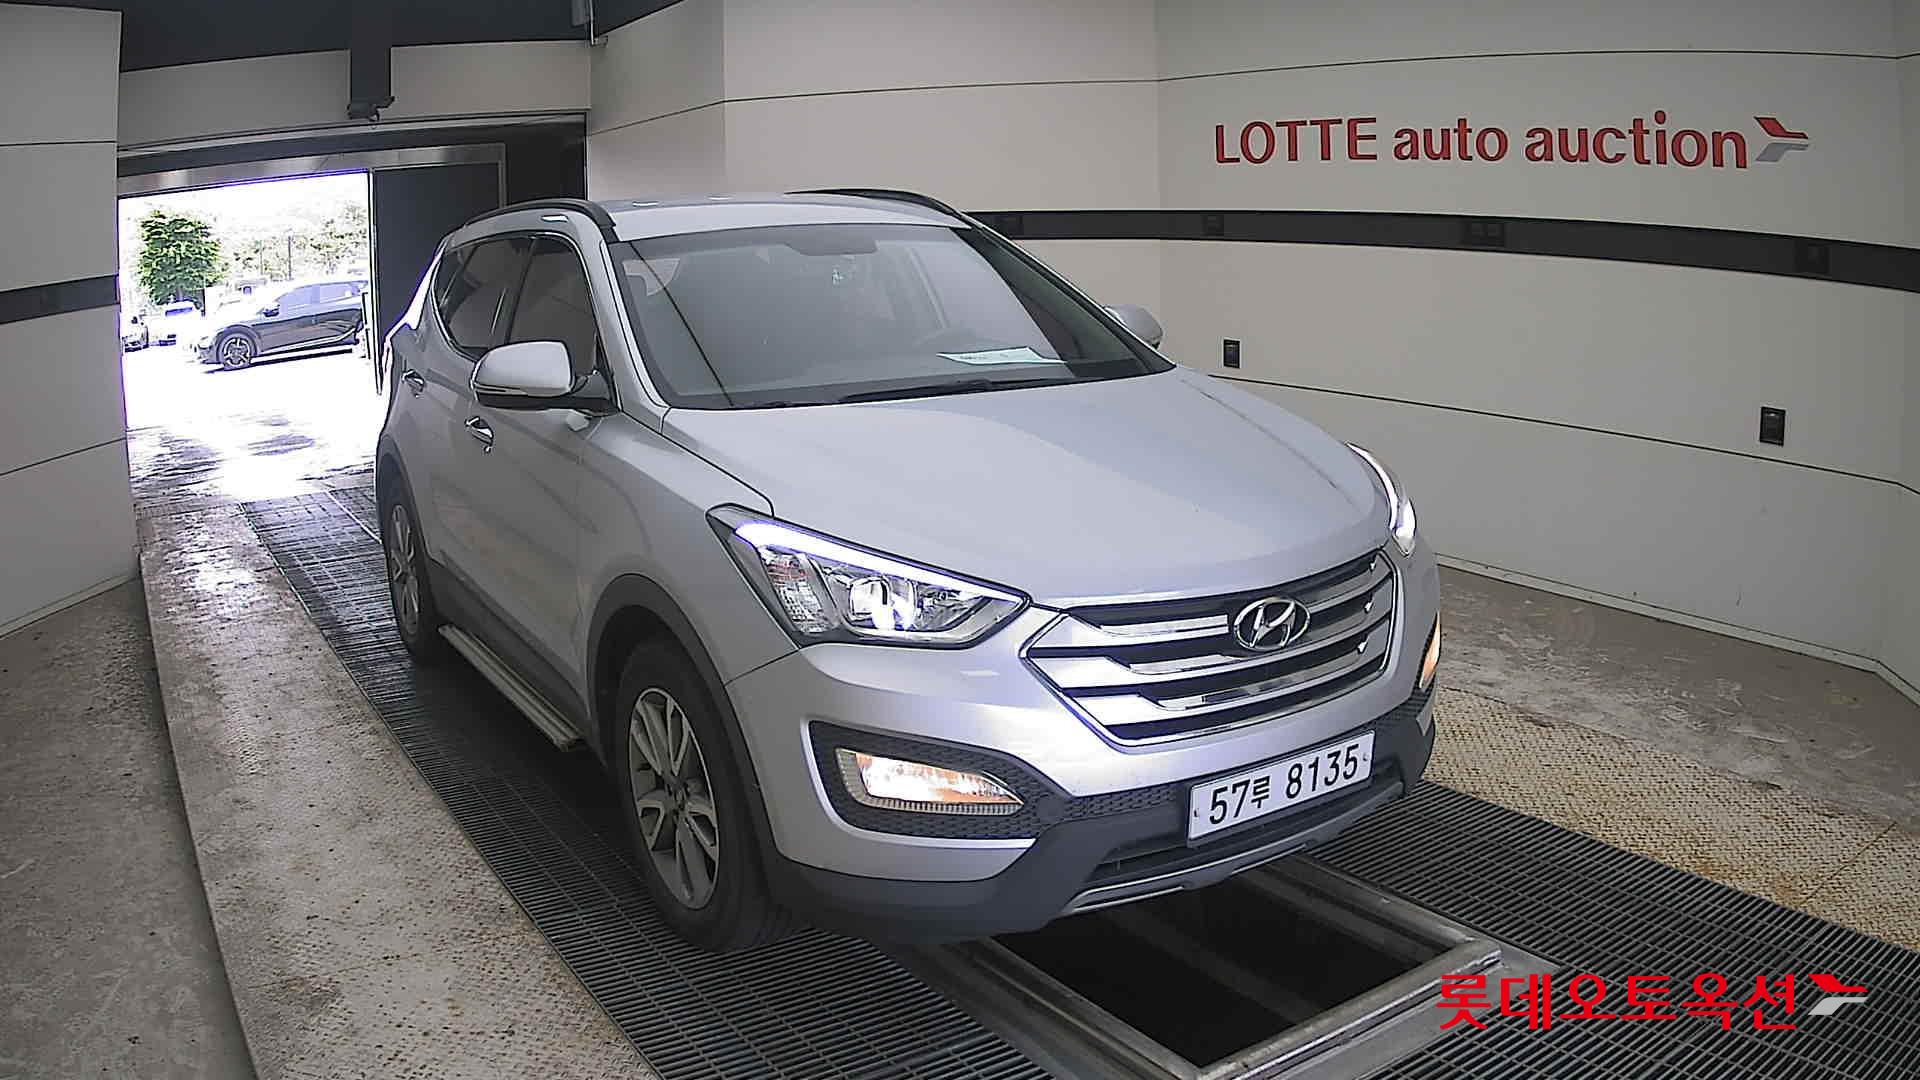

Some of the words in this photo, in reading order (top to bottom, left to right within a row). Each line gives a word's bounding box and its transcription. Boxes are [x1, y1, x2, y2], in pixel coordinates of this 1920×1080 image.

[1215, 117, 1377, 164] LOTTE
[1393, 117, 1509, 161] auto
[1524, 110, 1748, 169] auction
[1285, 743, 1359, 799] 8135
